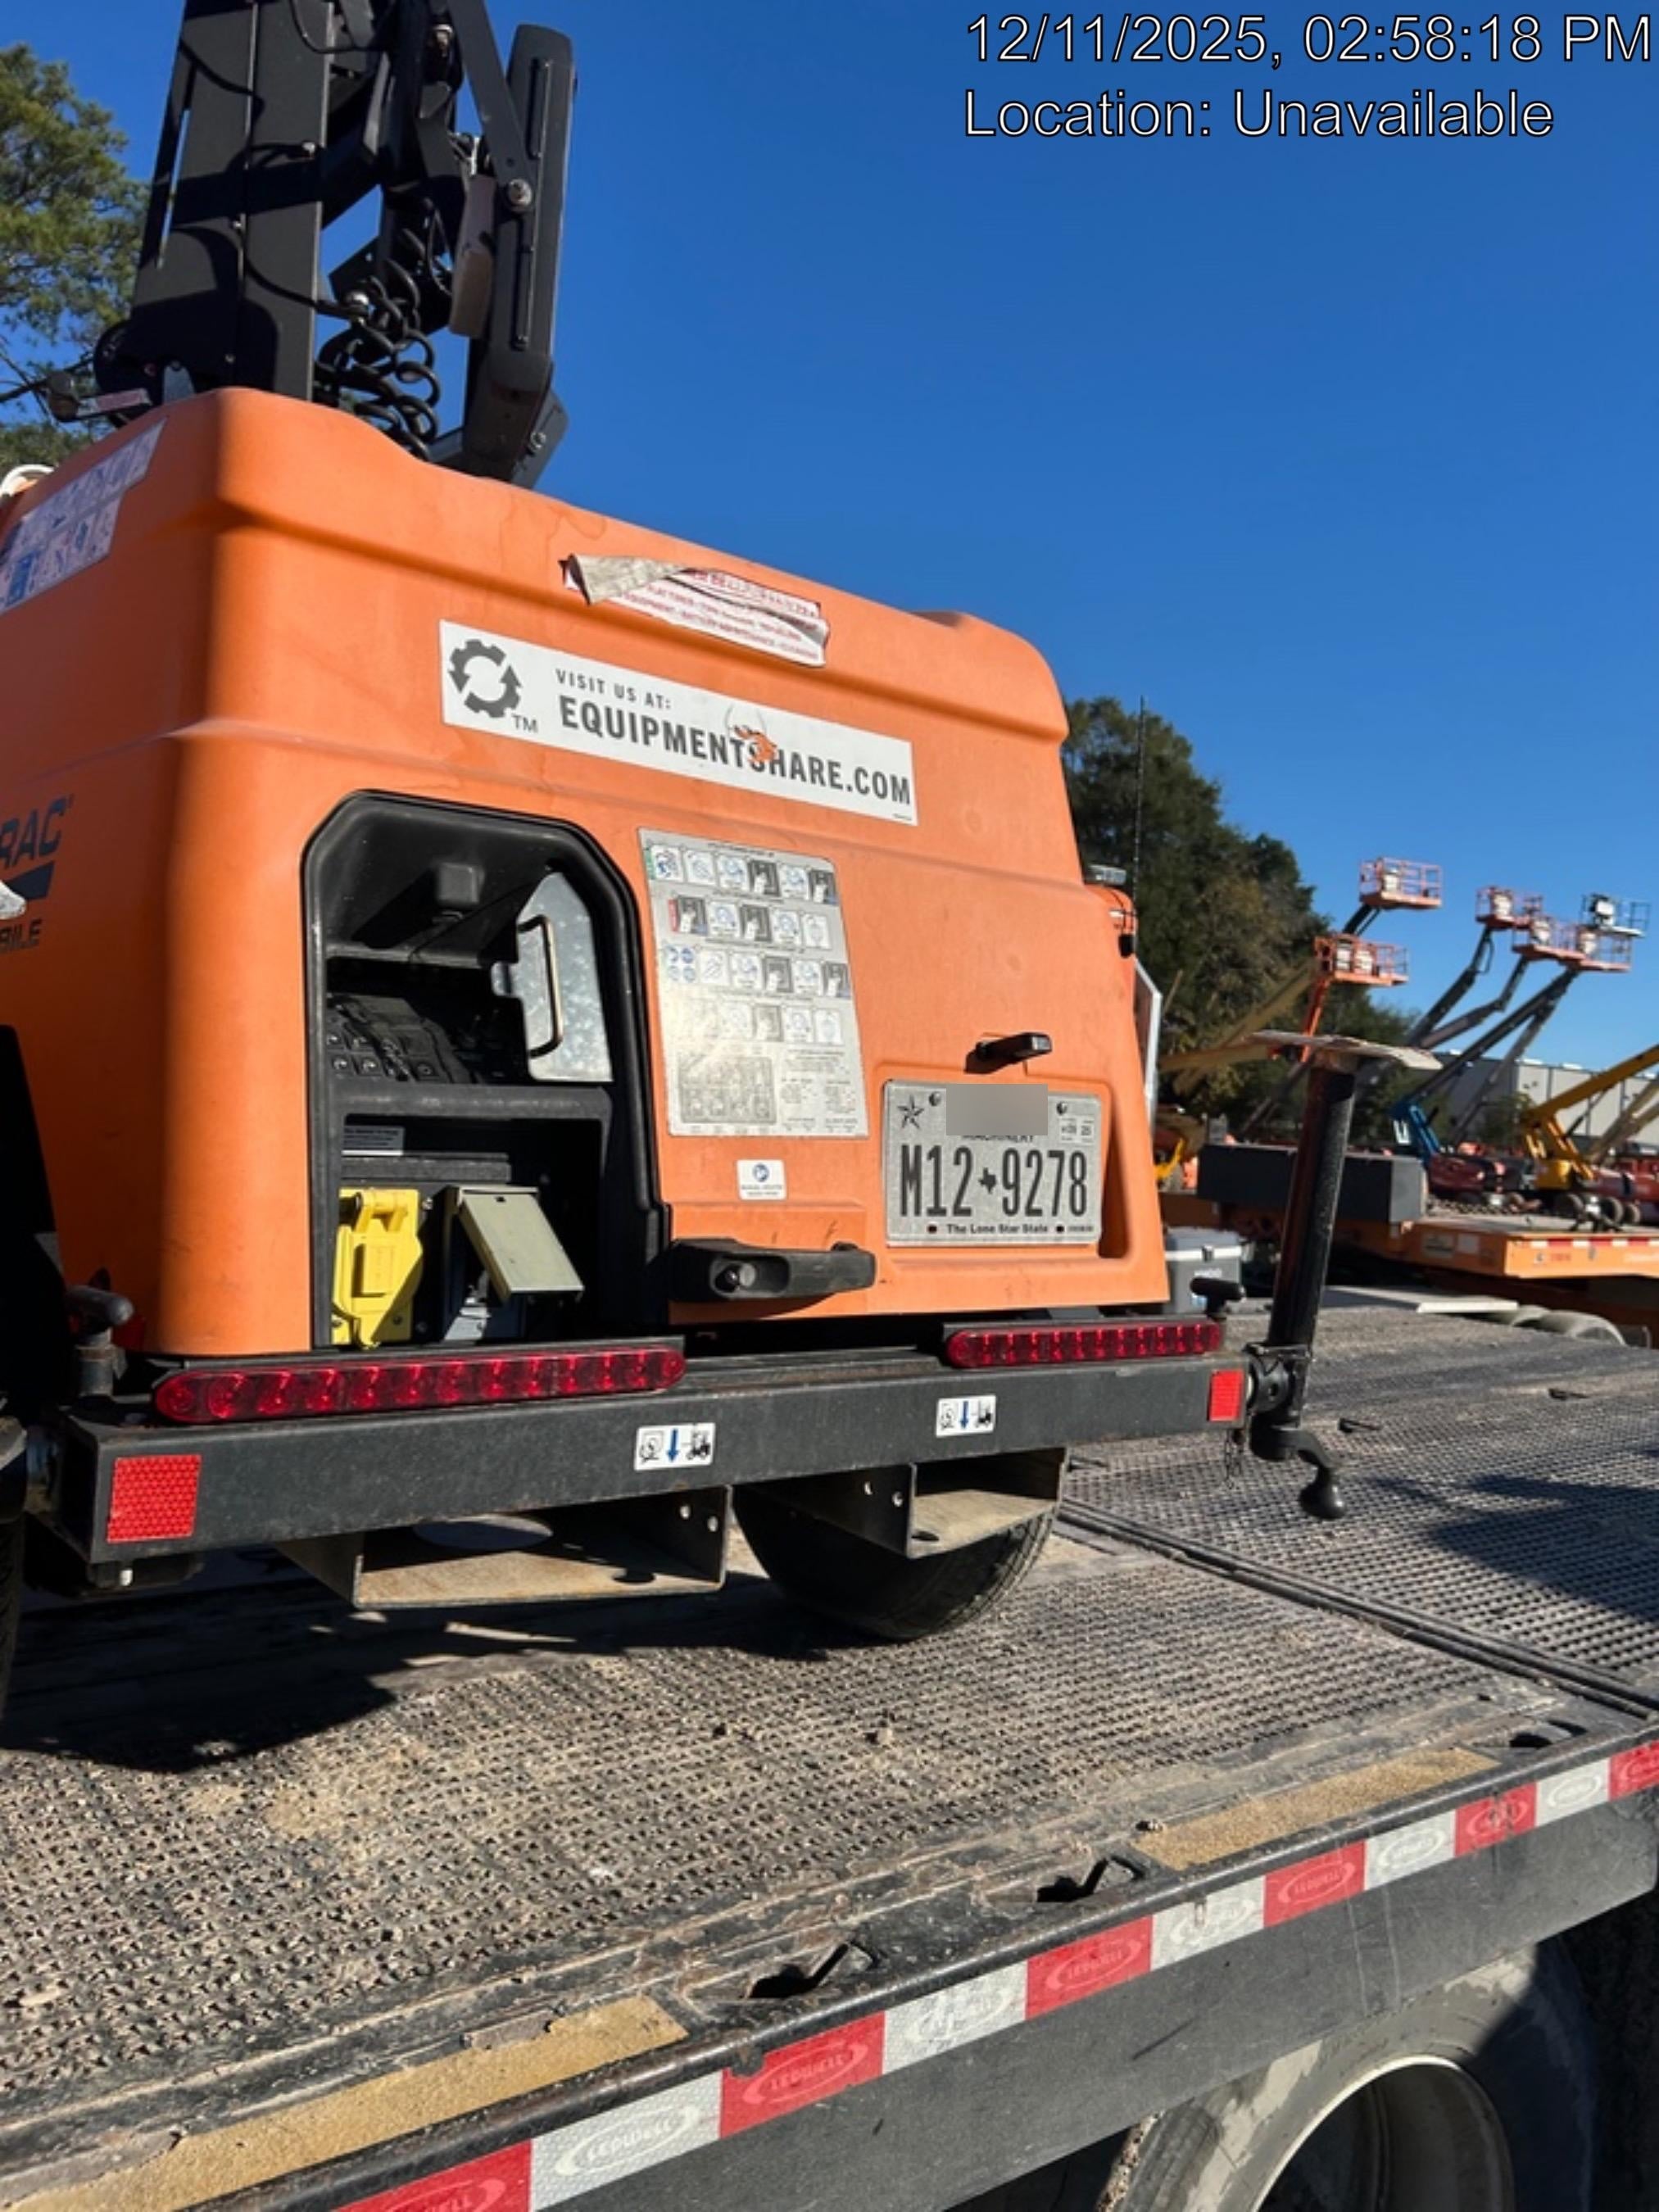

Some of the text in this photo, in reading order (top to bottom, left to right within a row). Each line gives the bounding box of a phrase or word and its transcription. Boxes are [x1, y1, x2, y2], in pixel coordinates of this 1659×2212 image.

[555, 669, 671, 709] VISIT US AT:
[512, 714, 538, 733] TM
[947, 1223, 1048, 1234] The Lone Star State
